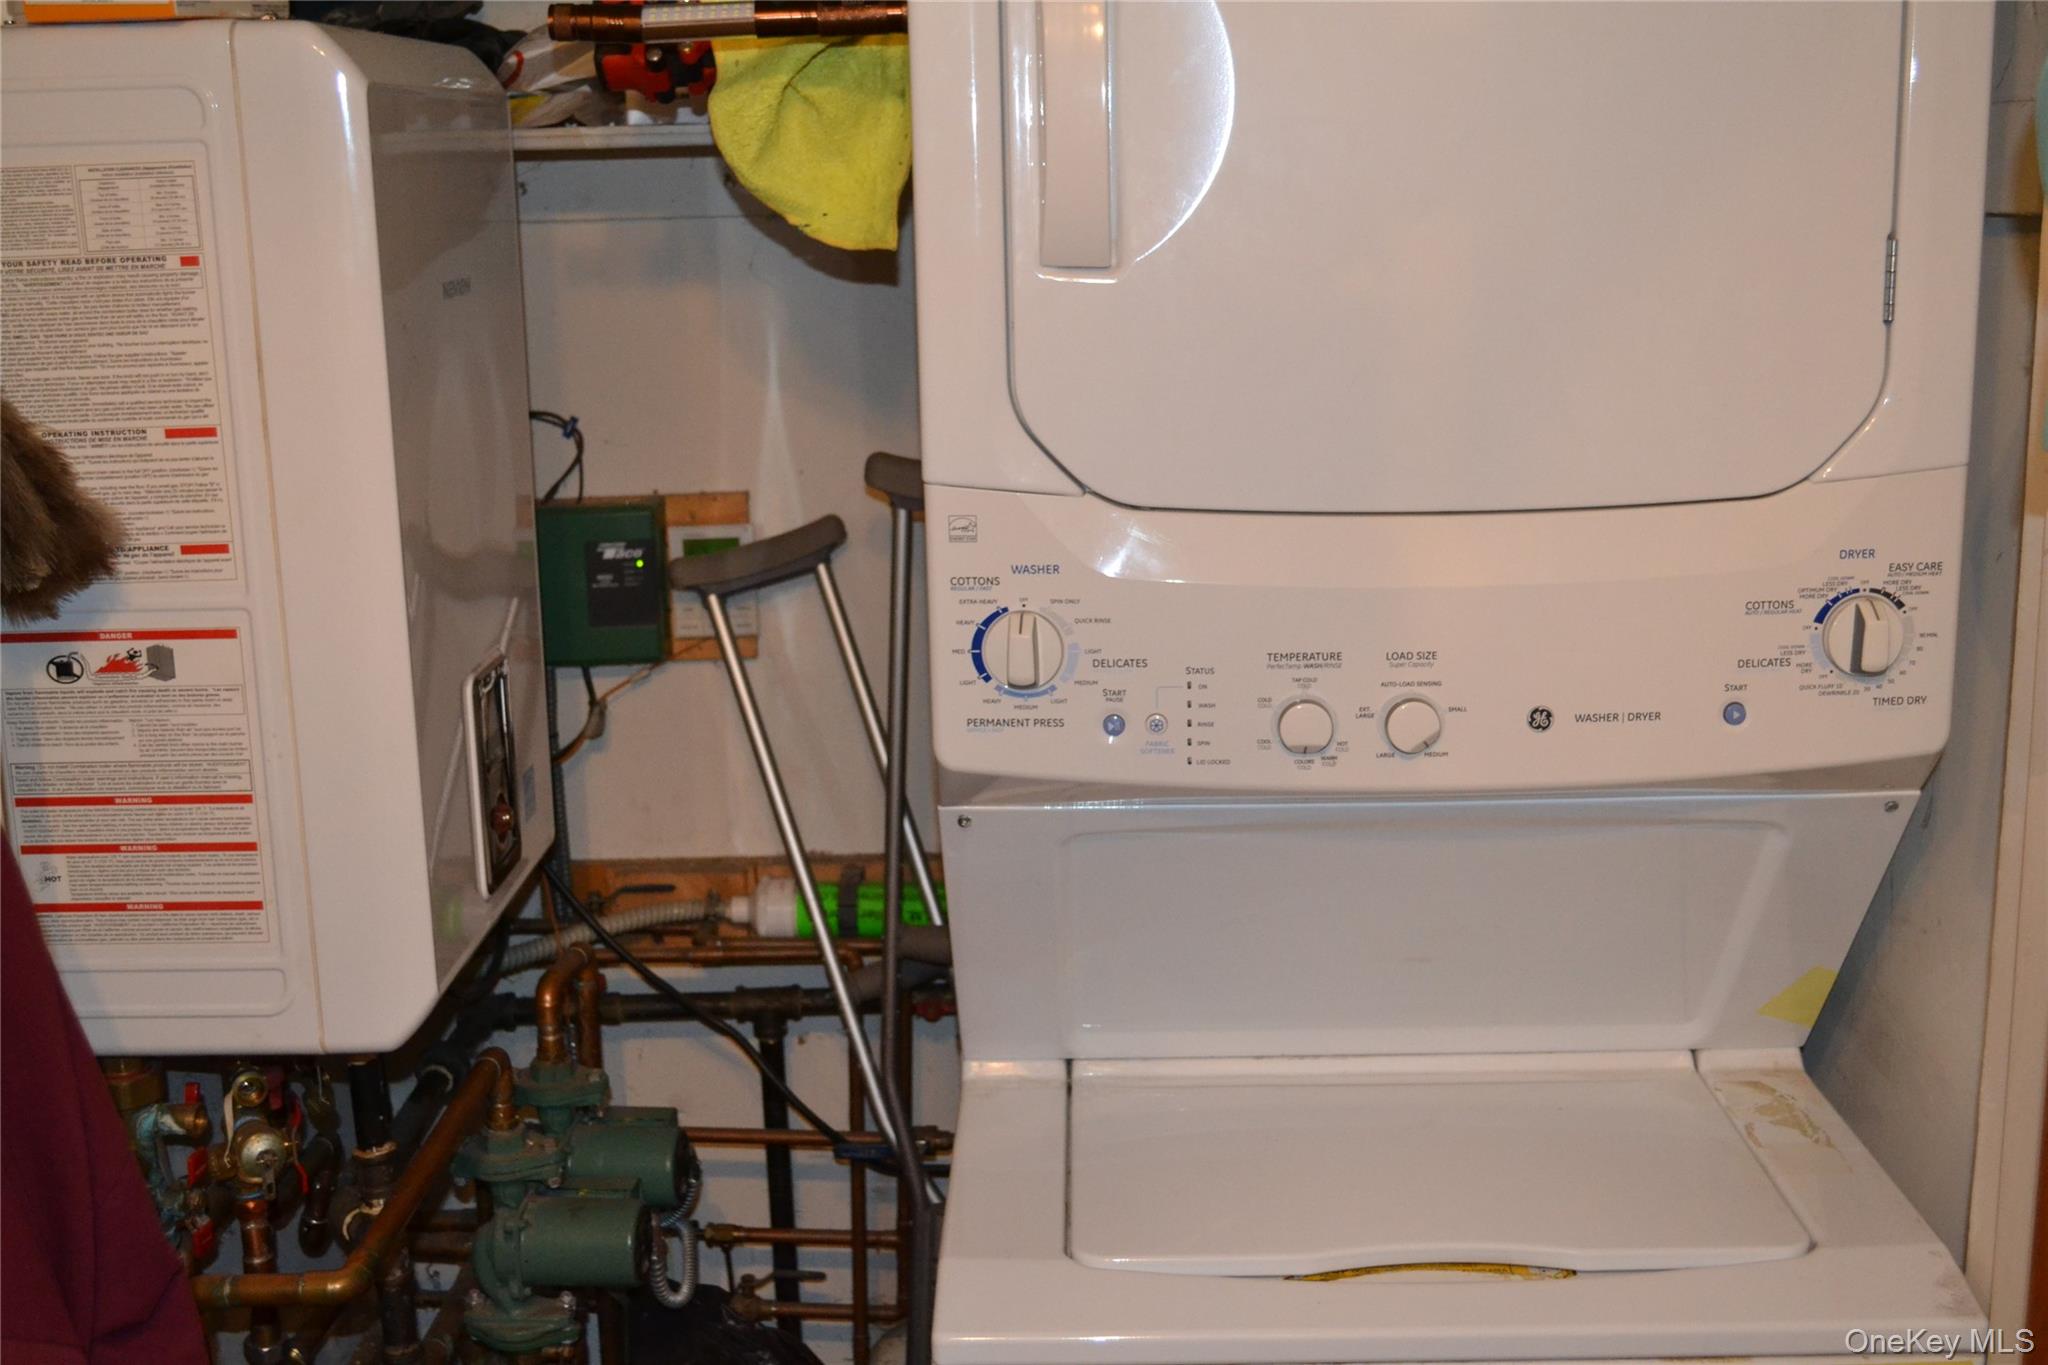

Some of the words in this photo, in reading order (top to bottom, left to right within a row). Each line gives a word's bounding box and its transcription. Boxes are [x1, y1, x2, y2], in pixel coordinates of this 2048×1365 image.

[60, 258, 82, 266] READ
[85, 257, 117, 265] BEFORE
[119, 255, 167, 264] OPERATING
[1839, 548, 1876, 560] DRYER
[1011, 564, 1061, 575] WASHER
[1888, 562, 1914, 572] EASY
[1916, 561, 1943, 571] CARE
[950, 576, 1001, 586] COTTONS
[1745, 600, 1795, 611] COTTONS
[100, 632, 133, 640] DANGER
[1266, 651, 1343, 662] TEMPERATURE
[1385, 651, 1414, 661] LOAD
[1416, 651, 1438, 660] SIZE
[1092, 658, 1149, 669] DELICATES
[1737, 657, 1792, 669] DELICATES
[1872, 697, 1904, 707] TIMED
[1906, 695, 1928, 706] DRY
[1574, 713, 1620, 723] WASHER
[1627, 711, 1662, 722] DRYER
[966, 718, 1030, 728] PERMANENT
[1033, 718, 1065, 728] PRESS
[44, 875, 62, 883] HOT
